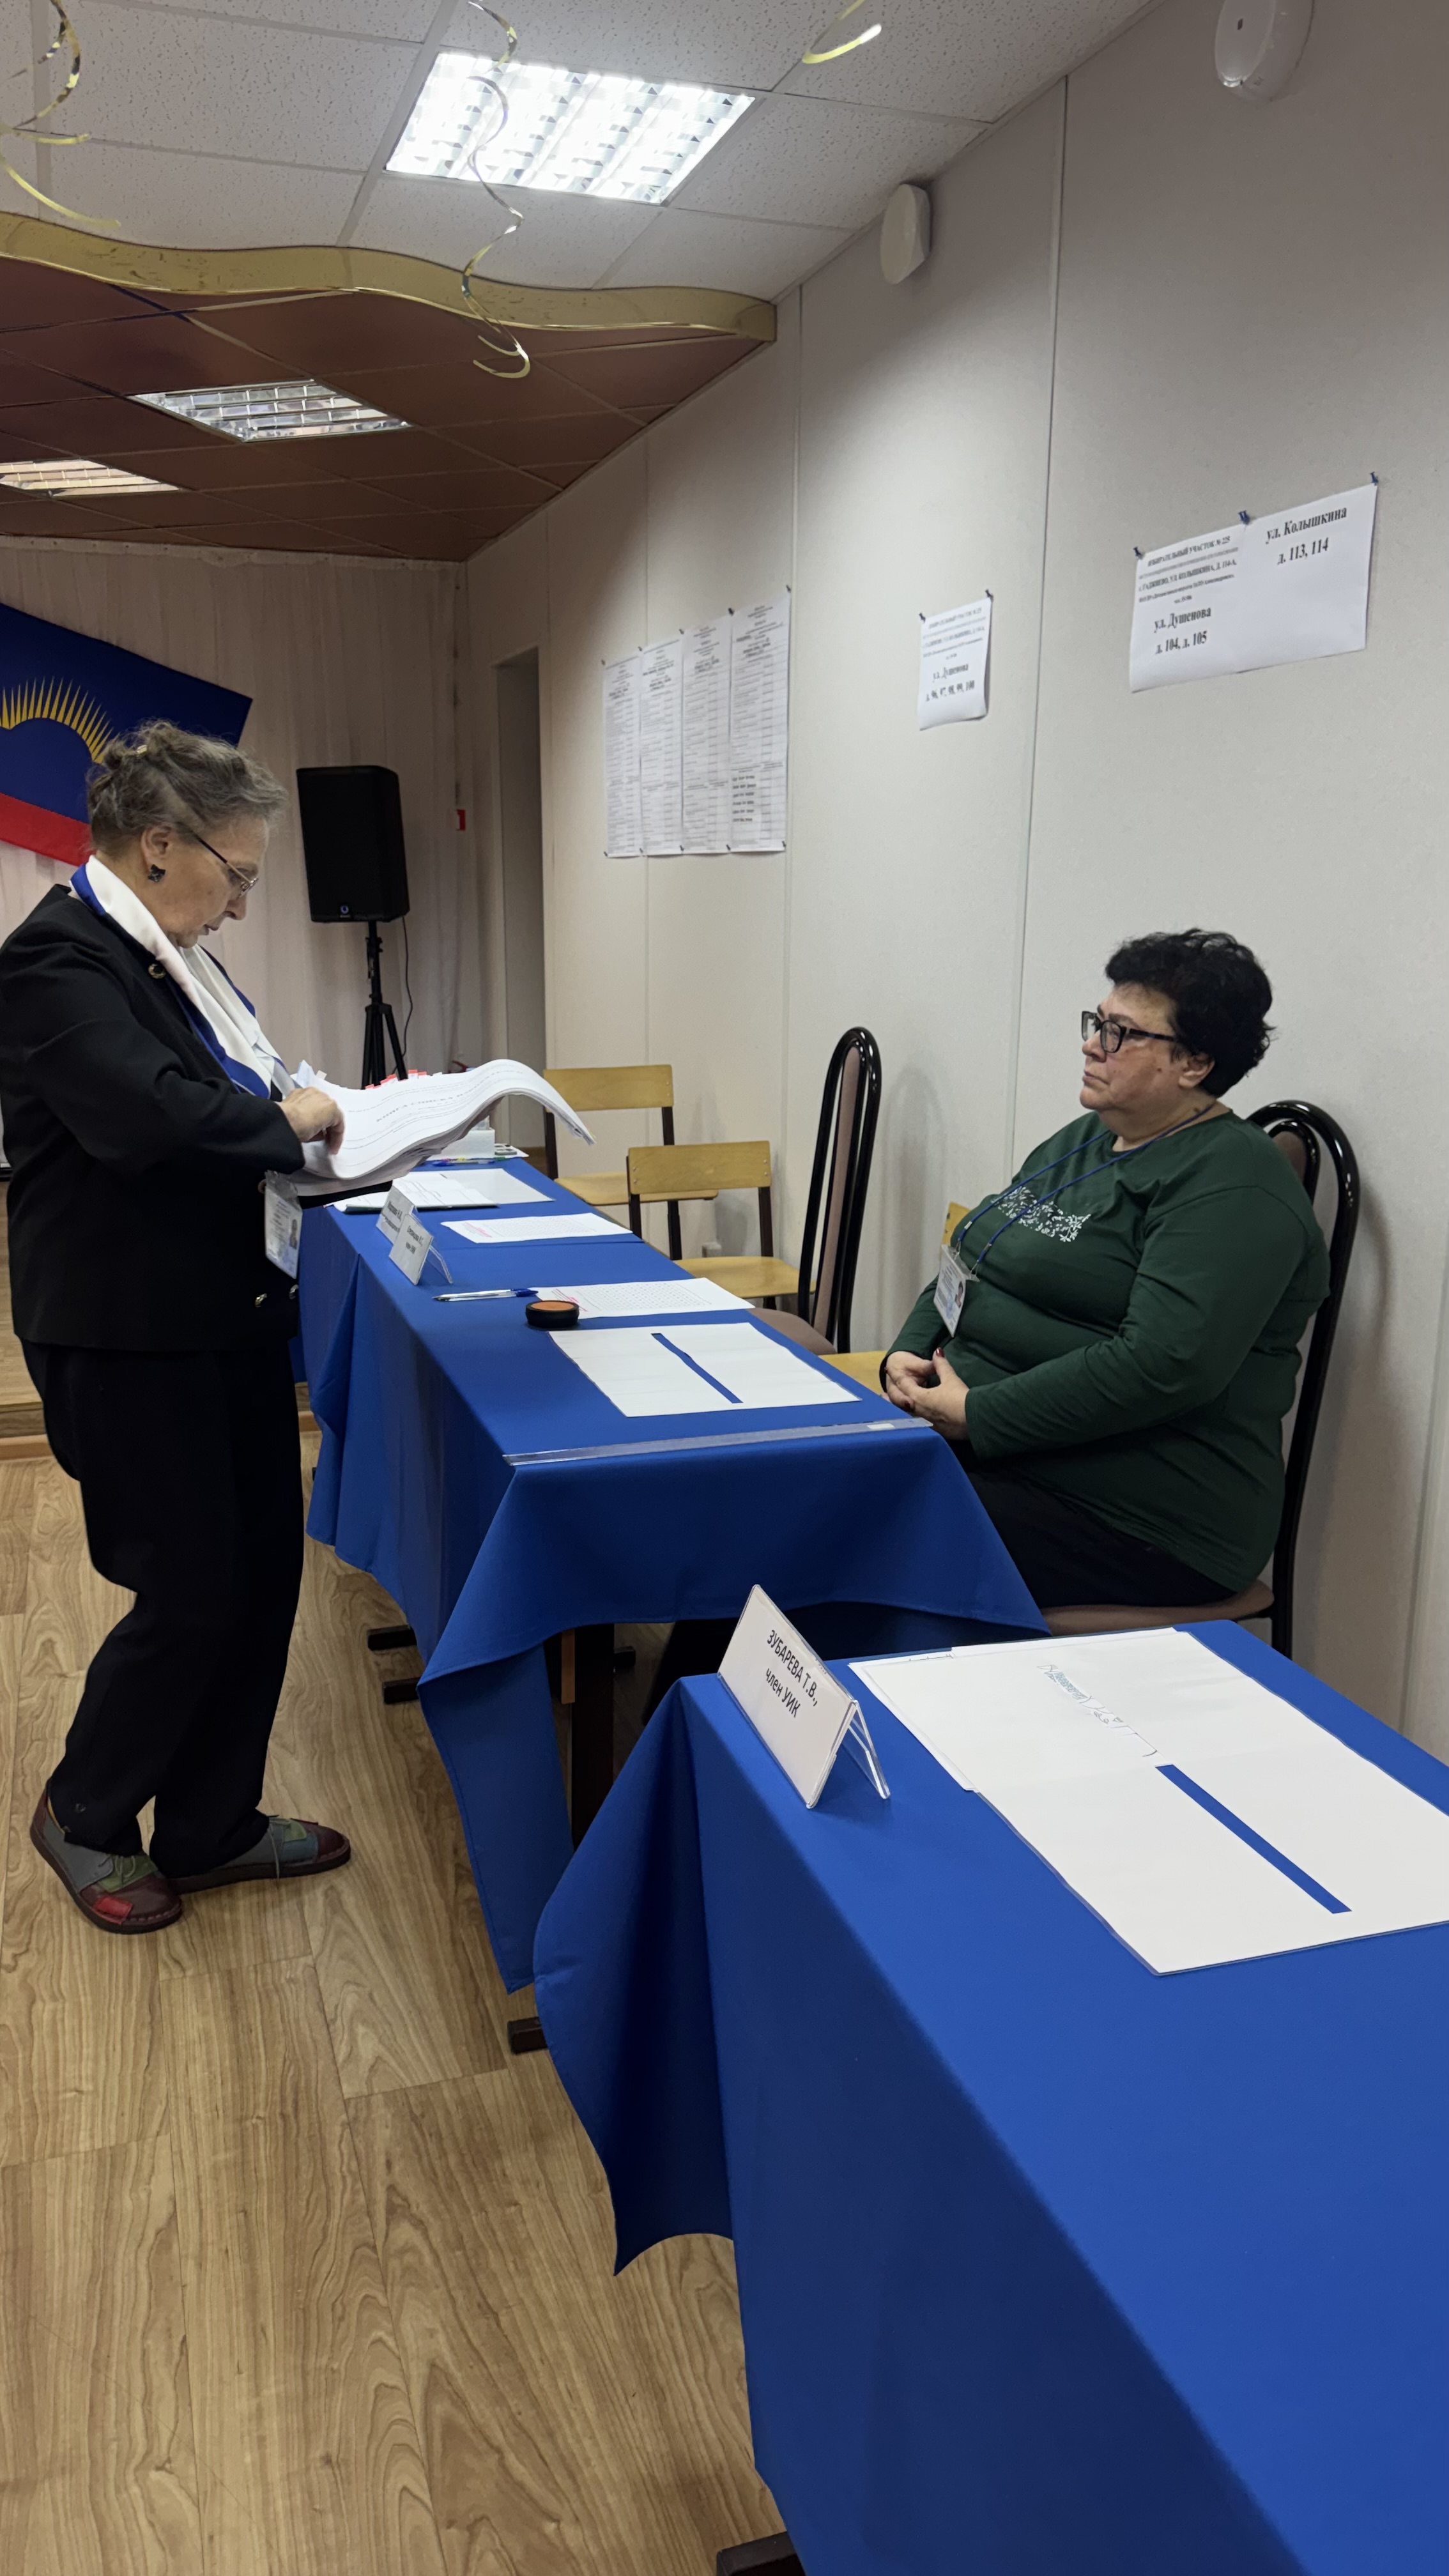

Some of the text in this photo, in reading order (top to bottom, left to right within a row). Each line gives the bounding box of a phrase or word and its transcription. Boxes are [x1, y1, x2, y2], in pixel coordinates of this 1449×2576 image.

[1266, 507, 1347, 545] ул. Колышкина
[1277, 537, 1329, 565] д. 113, 114
[1154, 607, 1211, 633] ул. Душенова
[1155, 644, 1162, 654] д.
[1193, 630, 1208, 646] 105
[767, 1629, 818, 1706] ЗУБАРЕВА Т.В.,
[766, 1667, 801, 1718] член УИК
